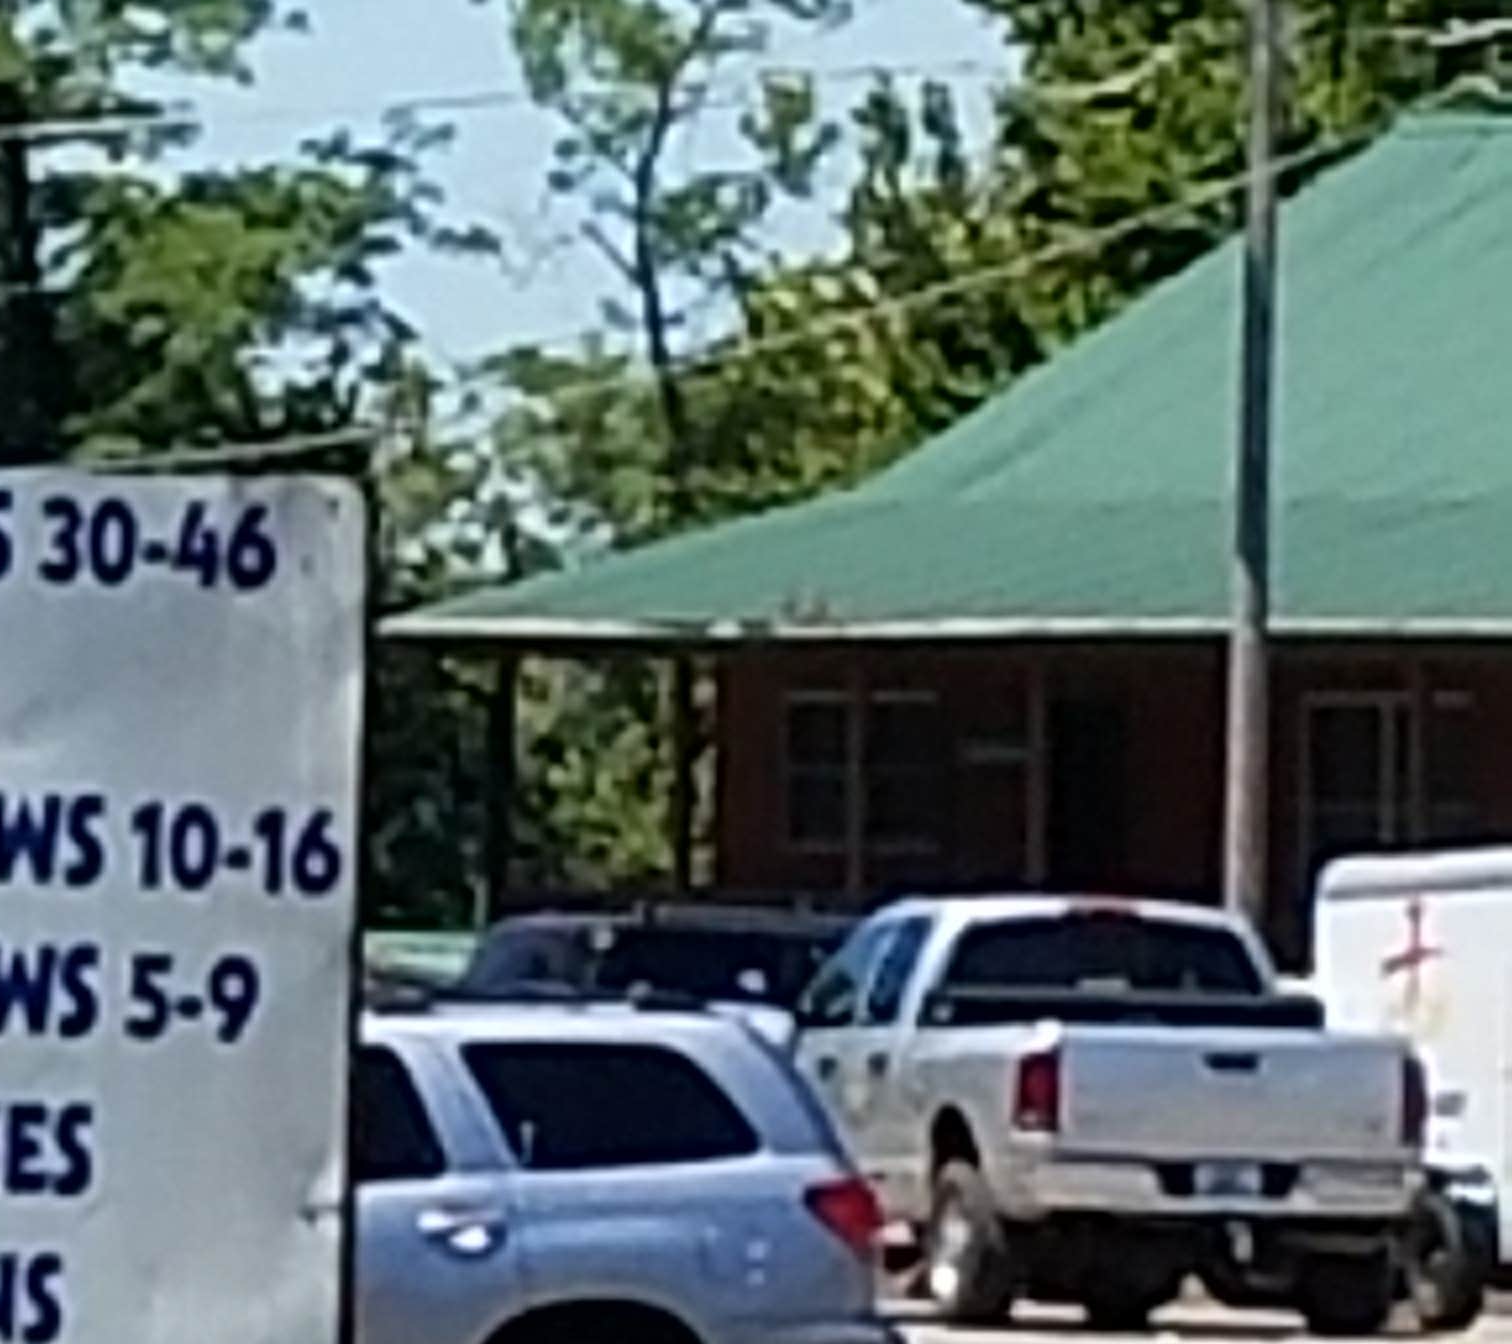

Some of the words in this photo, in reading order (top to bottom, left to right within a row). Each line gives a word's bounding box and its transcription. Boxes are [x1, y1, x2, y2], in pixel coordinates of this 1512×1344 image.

[38, 495, 278, 592] 30-46
[131, 799, 342, 898] 10-16
[124, 954, 260, 1043] 5-9
